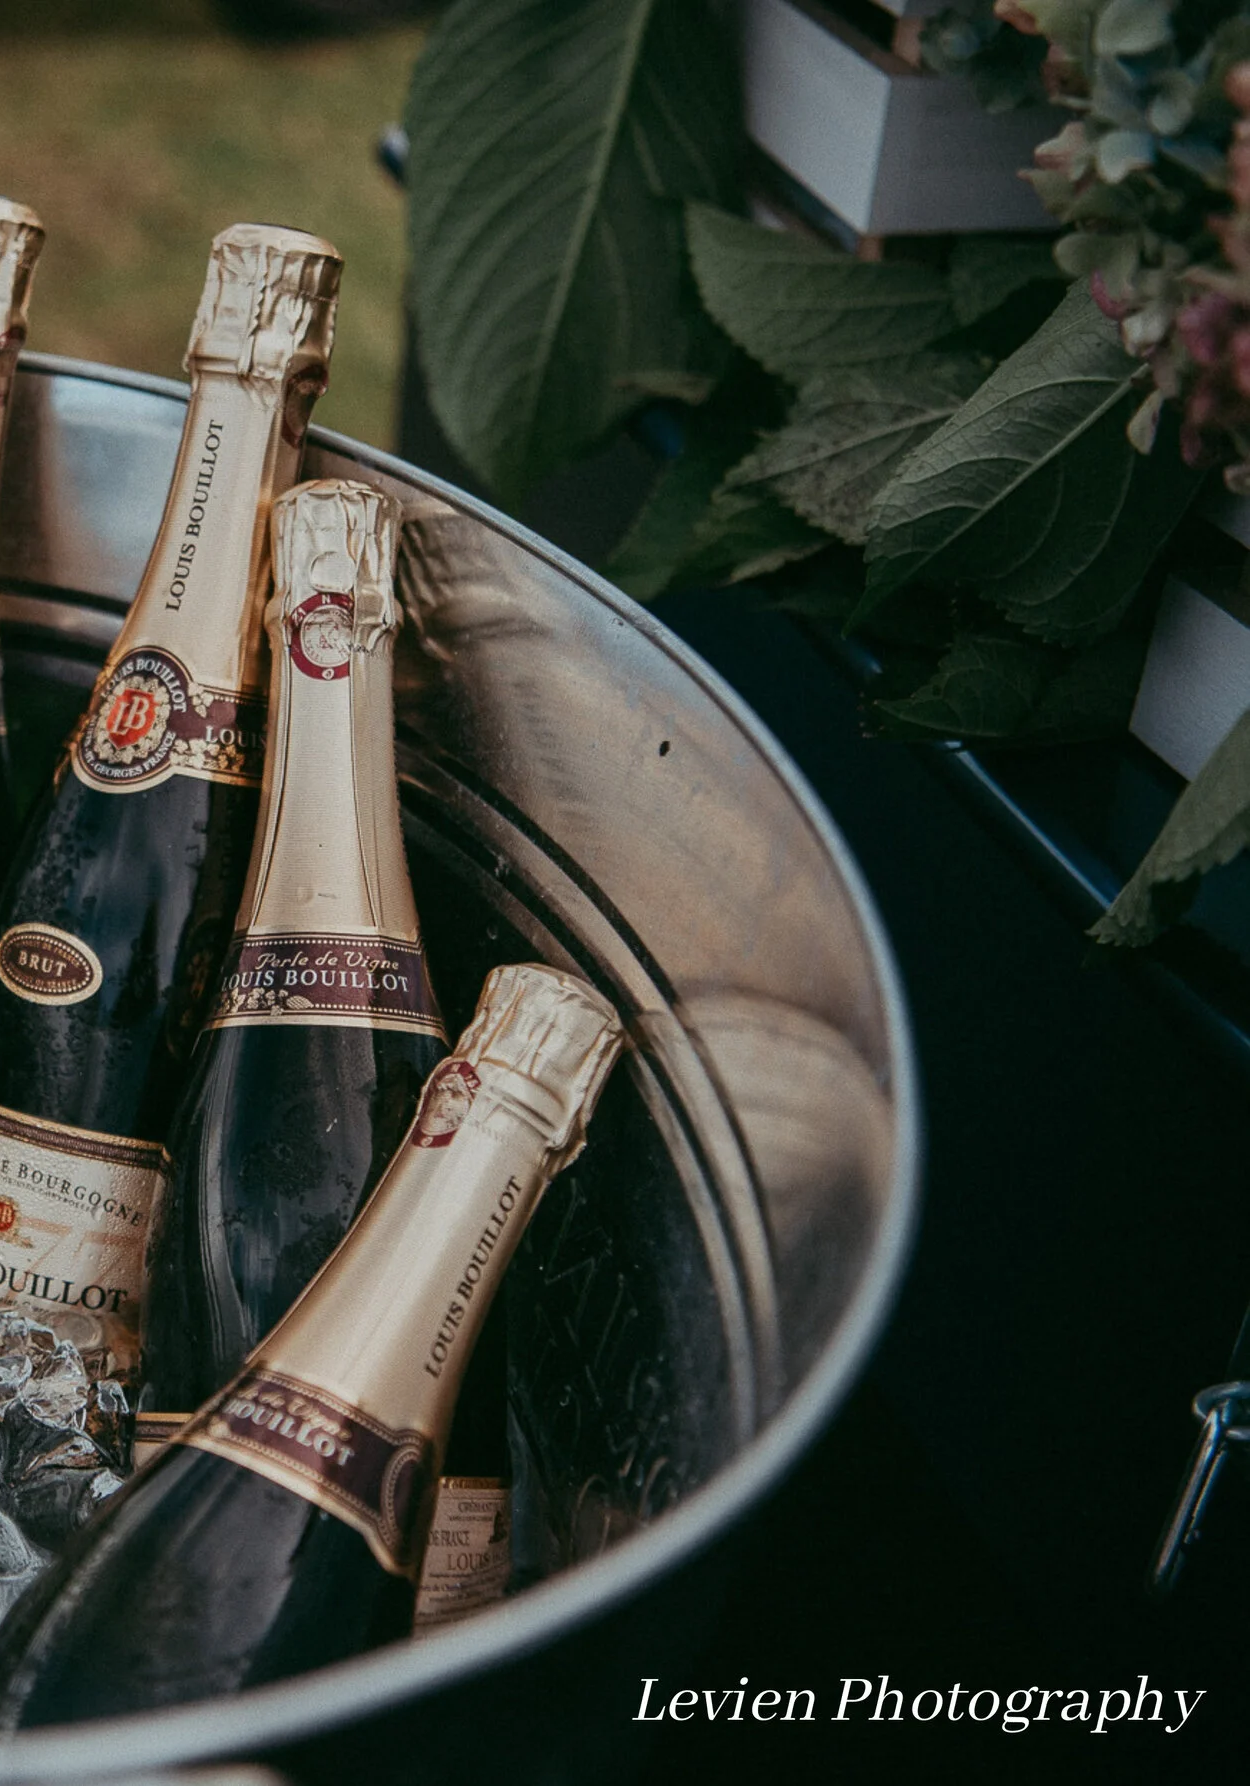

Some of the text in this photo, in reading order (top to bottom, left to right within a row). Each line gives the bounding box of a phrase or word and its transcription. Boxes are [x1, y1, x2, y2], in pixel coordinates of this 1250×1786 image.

[164, 419, 225, 612] LOUIS BOUILLOT
[135, 658, 187, 713] BOUILLOT
[111, 695, 150, 735] LB
[143, 730, 177, 771] FRANCE
[17, 949, 67, 978] BRUT
[221, 969, 410, 993] LOUIS BOUILLOT
[254, 950, 399, 973] Perle de Vigne
[17, 1162, 145, 1228] BOURGOGNE
[423, 1174, 525, 1381] LOUIS BOUILLOT
[446, 1552, 489, 1572] LOUIS
